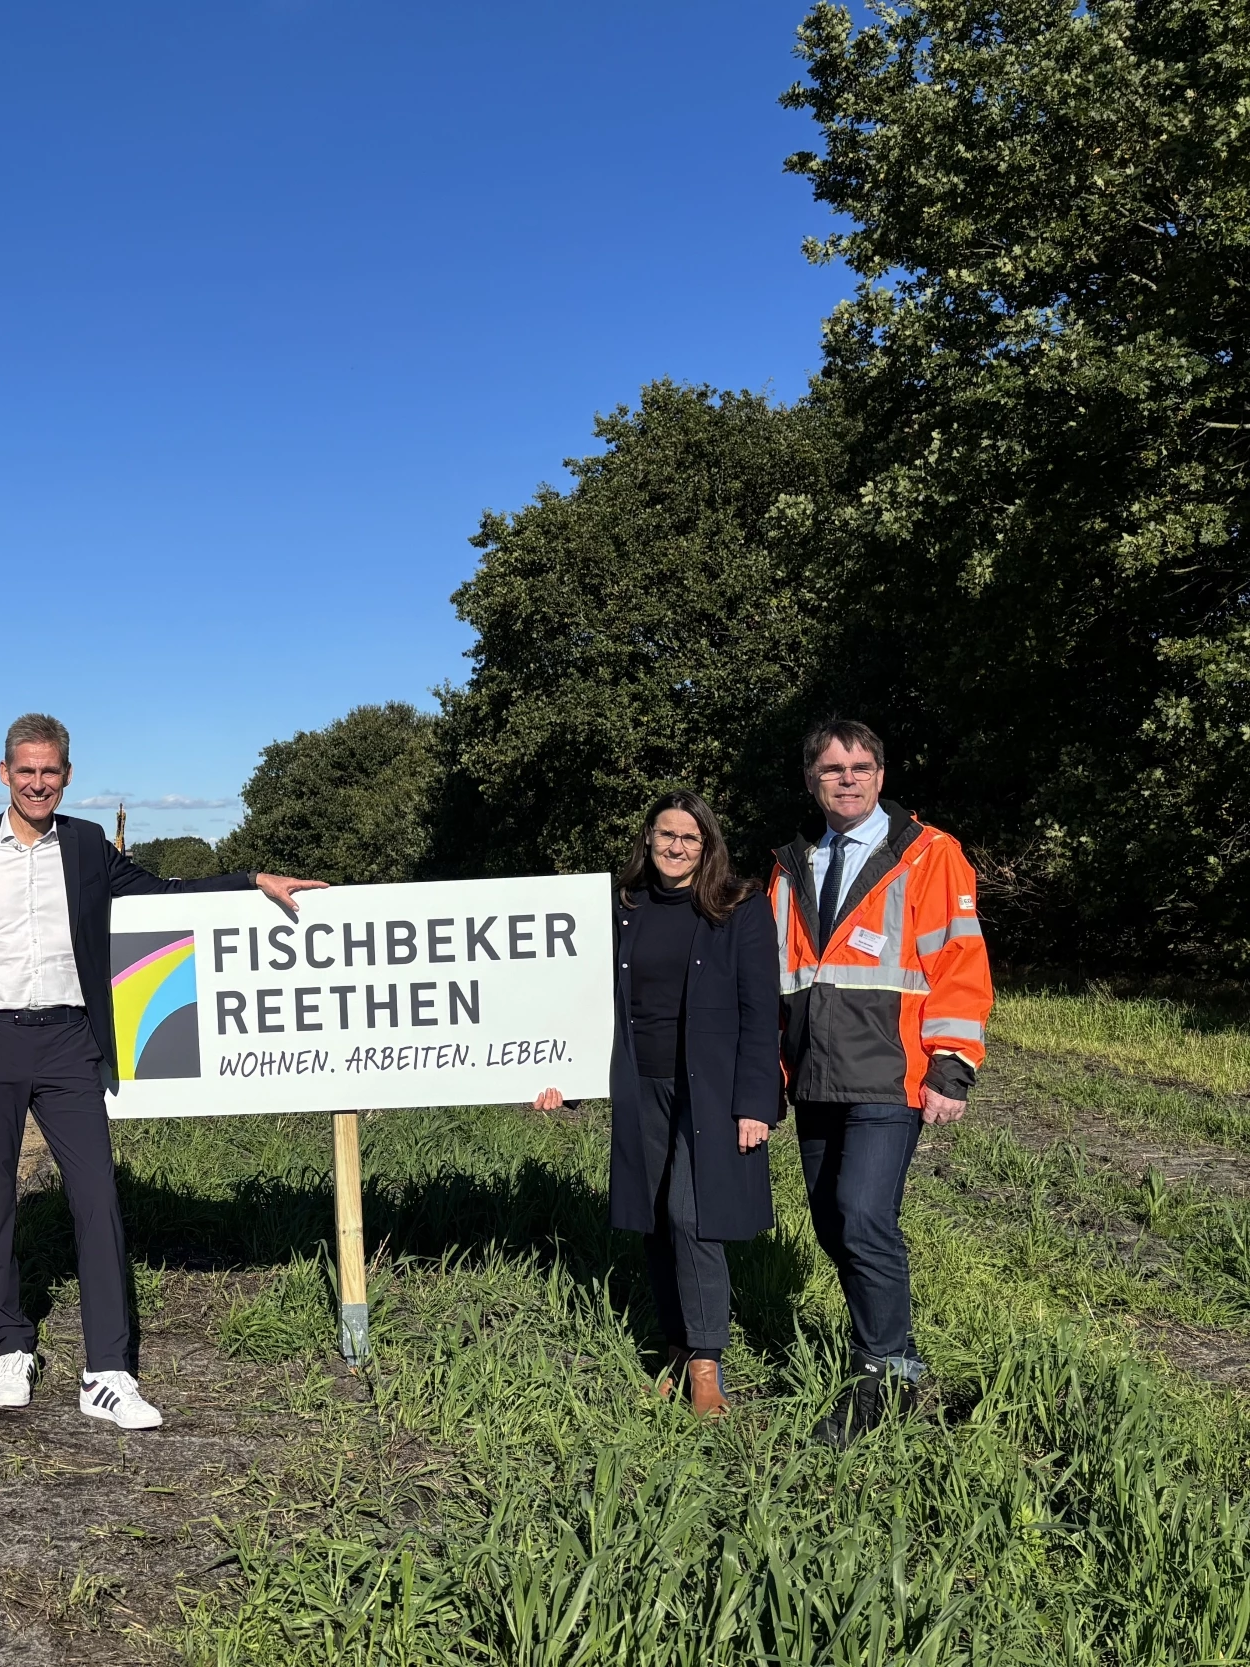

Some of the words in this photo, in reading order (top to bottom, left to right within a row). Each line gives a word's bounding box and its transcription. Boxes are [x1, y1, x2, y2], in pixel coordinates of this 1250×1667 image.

[213, 912, 578, 973] FISCHBEKER
[217, 979, 480, 1035] REETHEN
[219, 1049, 336, 1078] WOHNEN.
[344, 1043, 477, 1074] ARBEITEN.
[486, 1038, 574, 1067] LEBEN.
